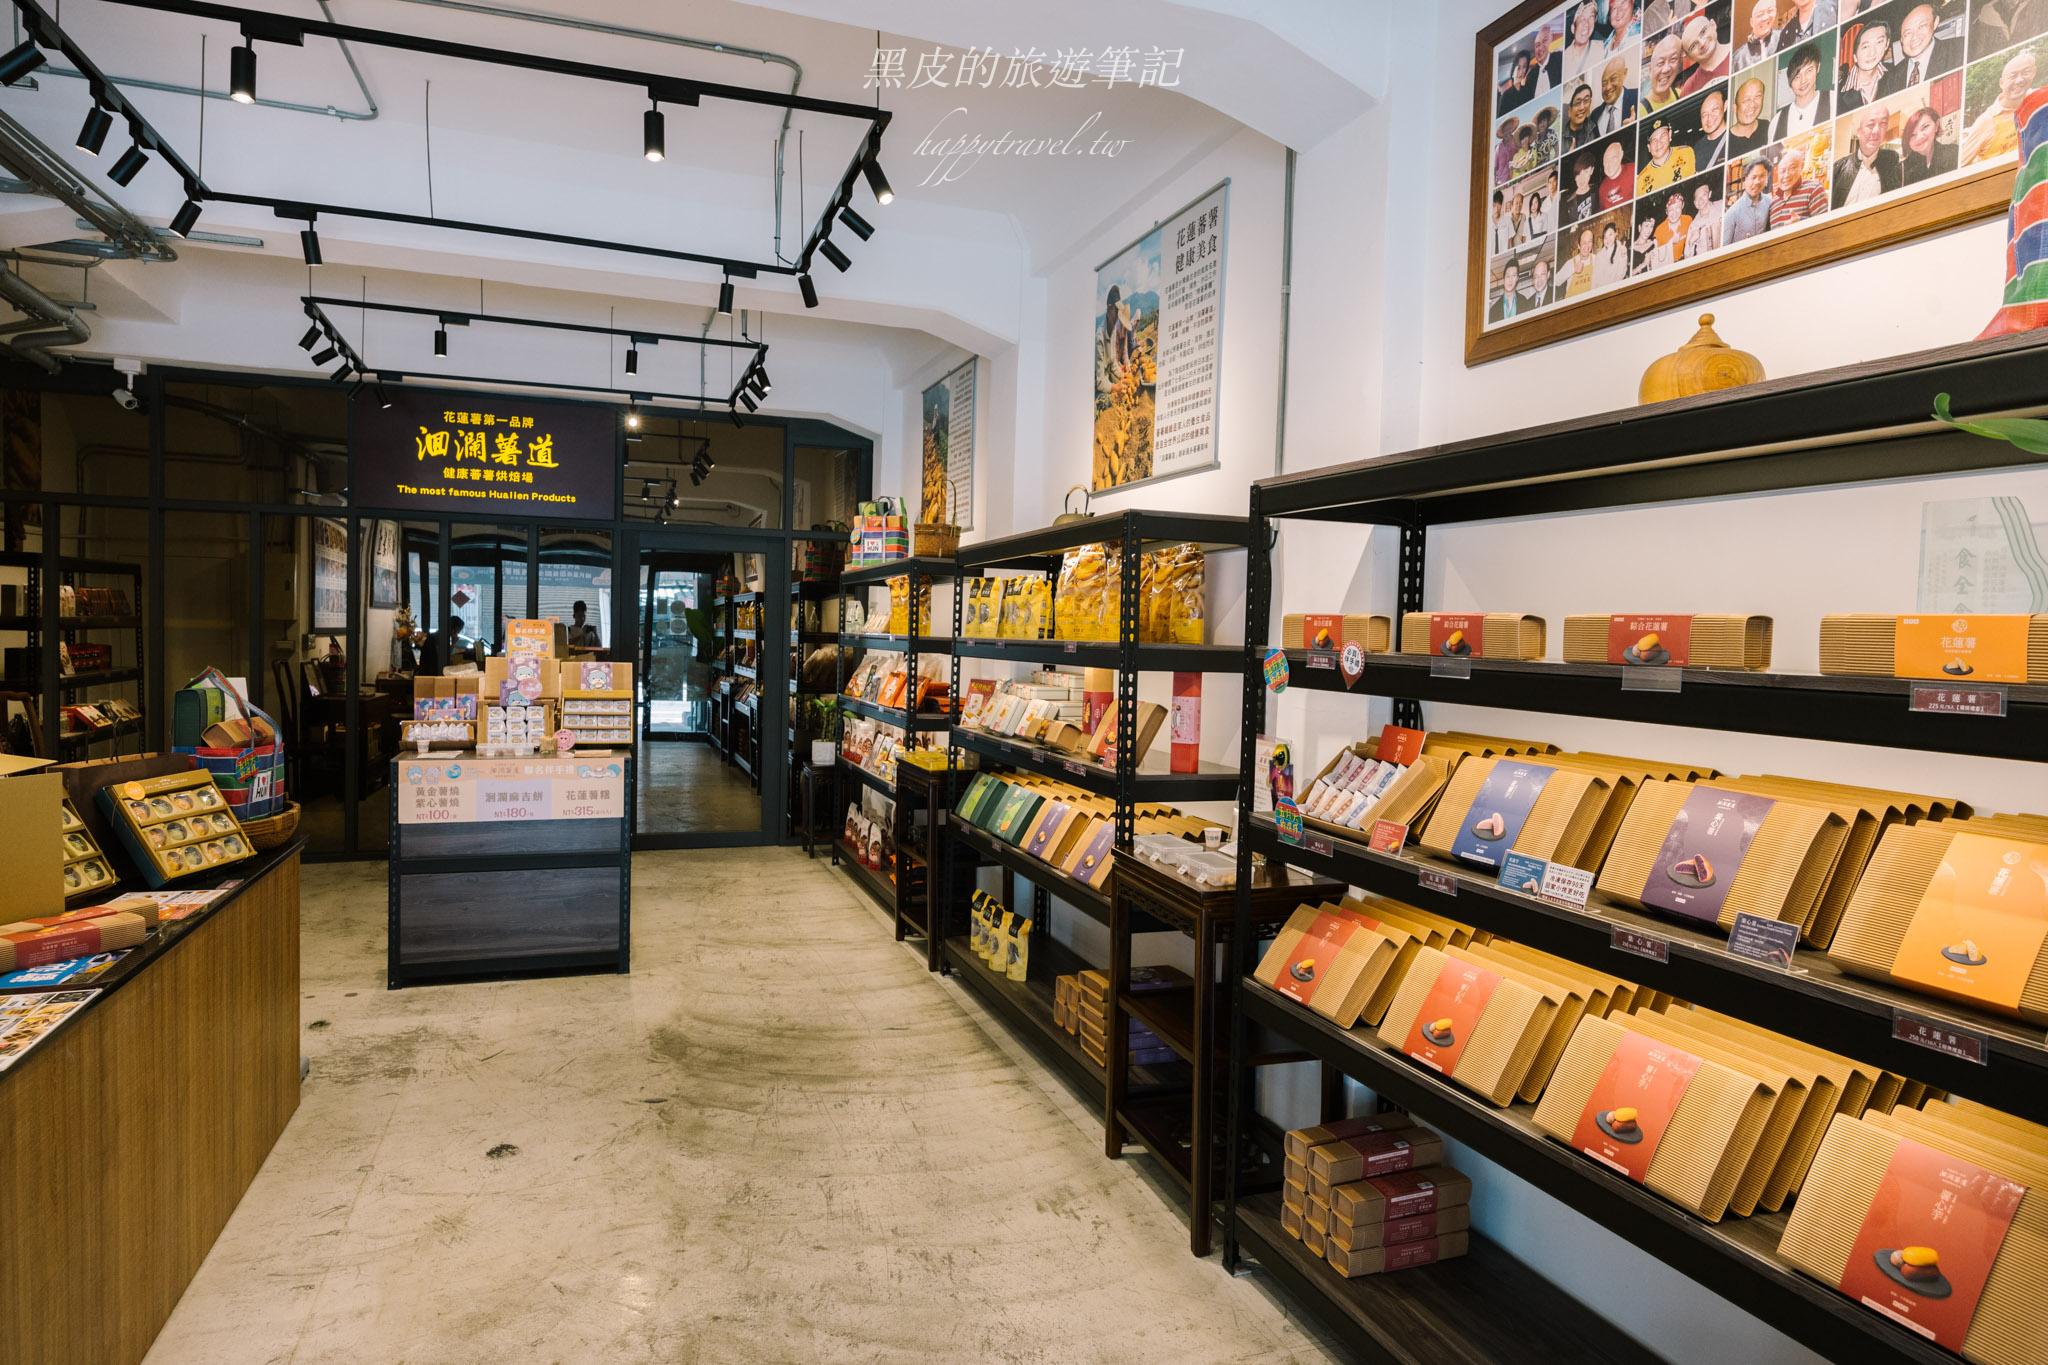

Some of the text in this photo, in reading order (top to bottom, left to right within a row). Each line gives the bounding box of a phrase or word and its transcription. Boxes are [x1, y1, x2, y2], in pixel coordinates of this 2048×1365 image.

[1175, 234, 1217, 274] 健康美食
[443, 411, 534, 429] 花蓮薯第一品牌
[416, 426, 559, 468] 洄瀾薯道
[443, 467, 534, 483] 健康蕃薯烘焙場
[397, 485, 576, 503] The most famous Hualien Products
[1630, 622, 1668, 631] 綜合花蓮薯
[1942, 637, 1977, 648] 花蓮薯
[1937, 693, 1977, 704] 花蓮薯
[416, 786, 459, 797] 黃金薯燒
[416, 798, 459, 808] 紫心薯燒
